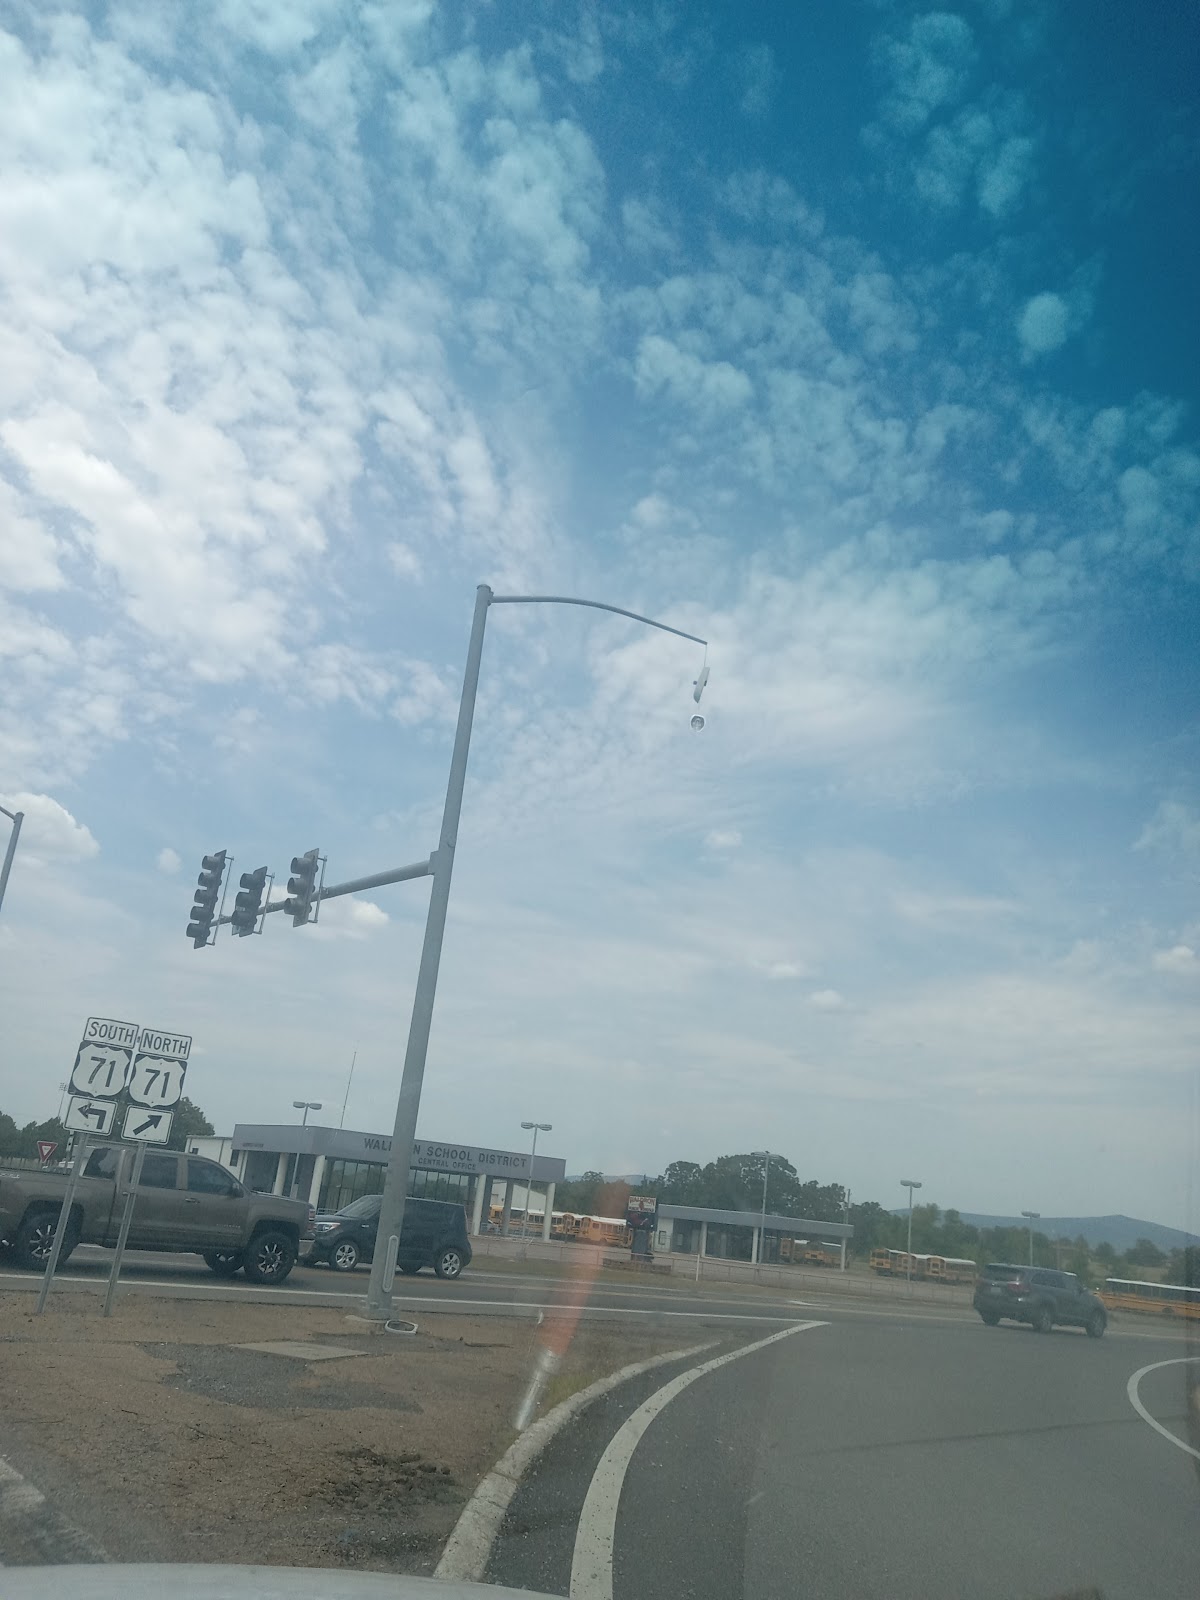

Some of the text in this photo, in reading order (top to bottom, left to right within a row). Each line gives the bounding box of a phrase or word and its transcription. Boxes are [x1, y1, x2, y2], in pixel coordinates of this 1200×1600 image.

[88, 1021, 135, 1044] SOUTH
[142, 1032, 189, 1055] NORTH
[88, 1056, 116, 1087] 71
[143, 1068, 170, 1098] 71
[364, 1137, 527, 1168] WALN SCHOOL DISTRICT
[418, 1157, 476, 1171] CENTRAL OFFICE
